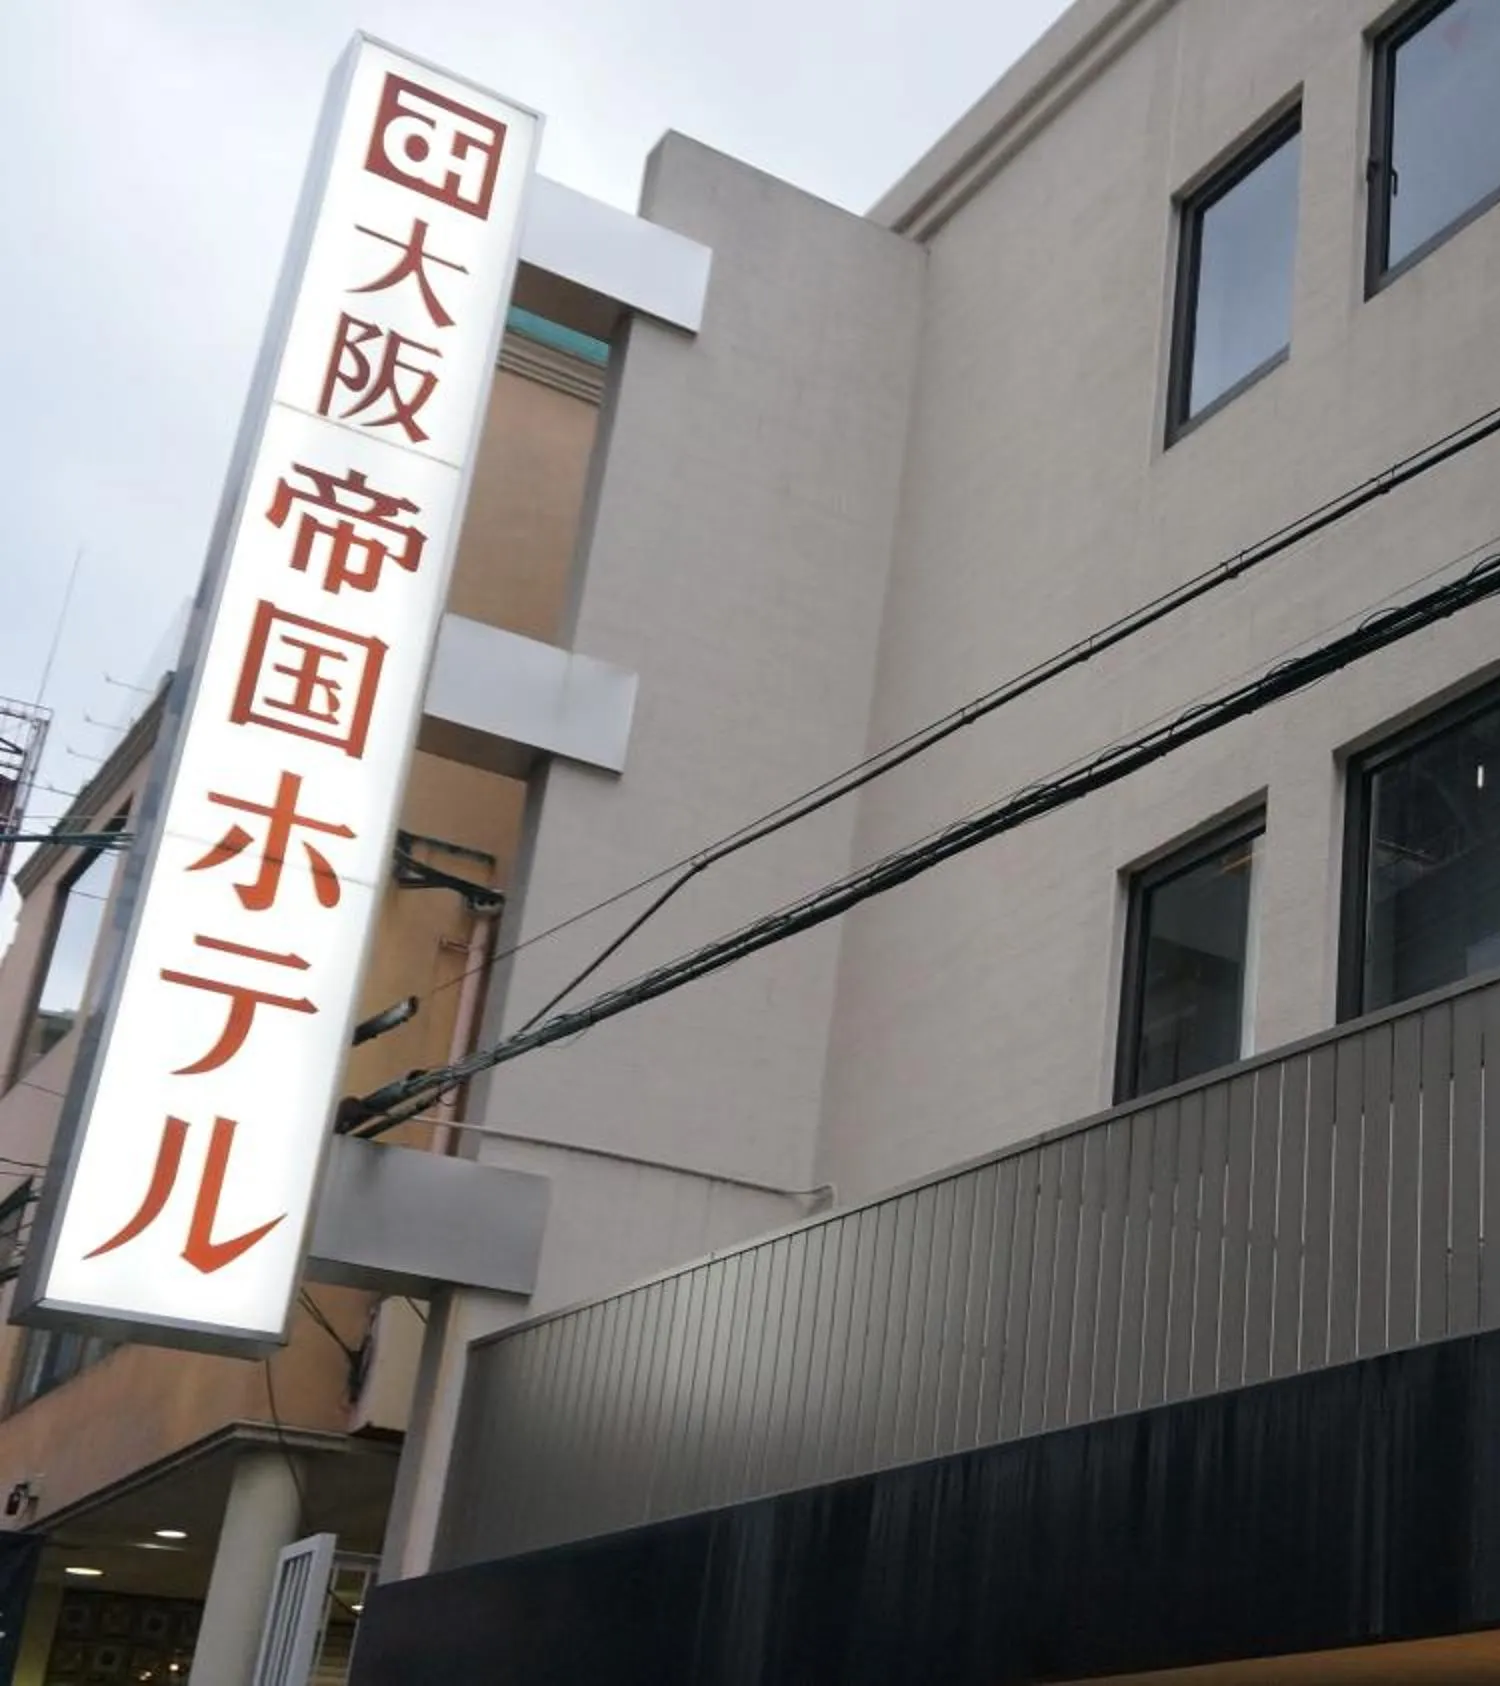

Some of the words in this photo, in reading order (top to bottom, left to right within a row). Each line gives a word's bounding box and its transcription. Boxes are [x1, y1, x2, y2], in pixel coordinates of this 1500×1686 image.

[81, 216, 469, 1275] 大阪帝国ホテル
